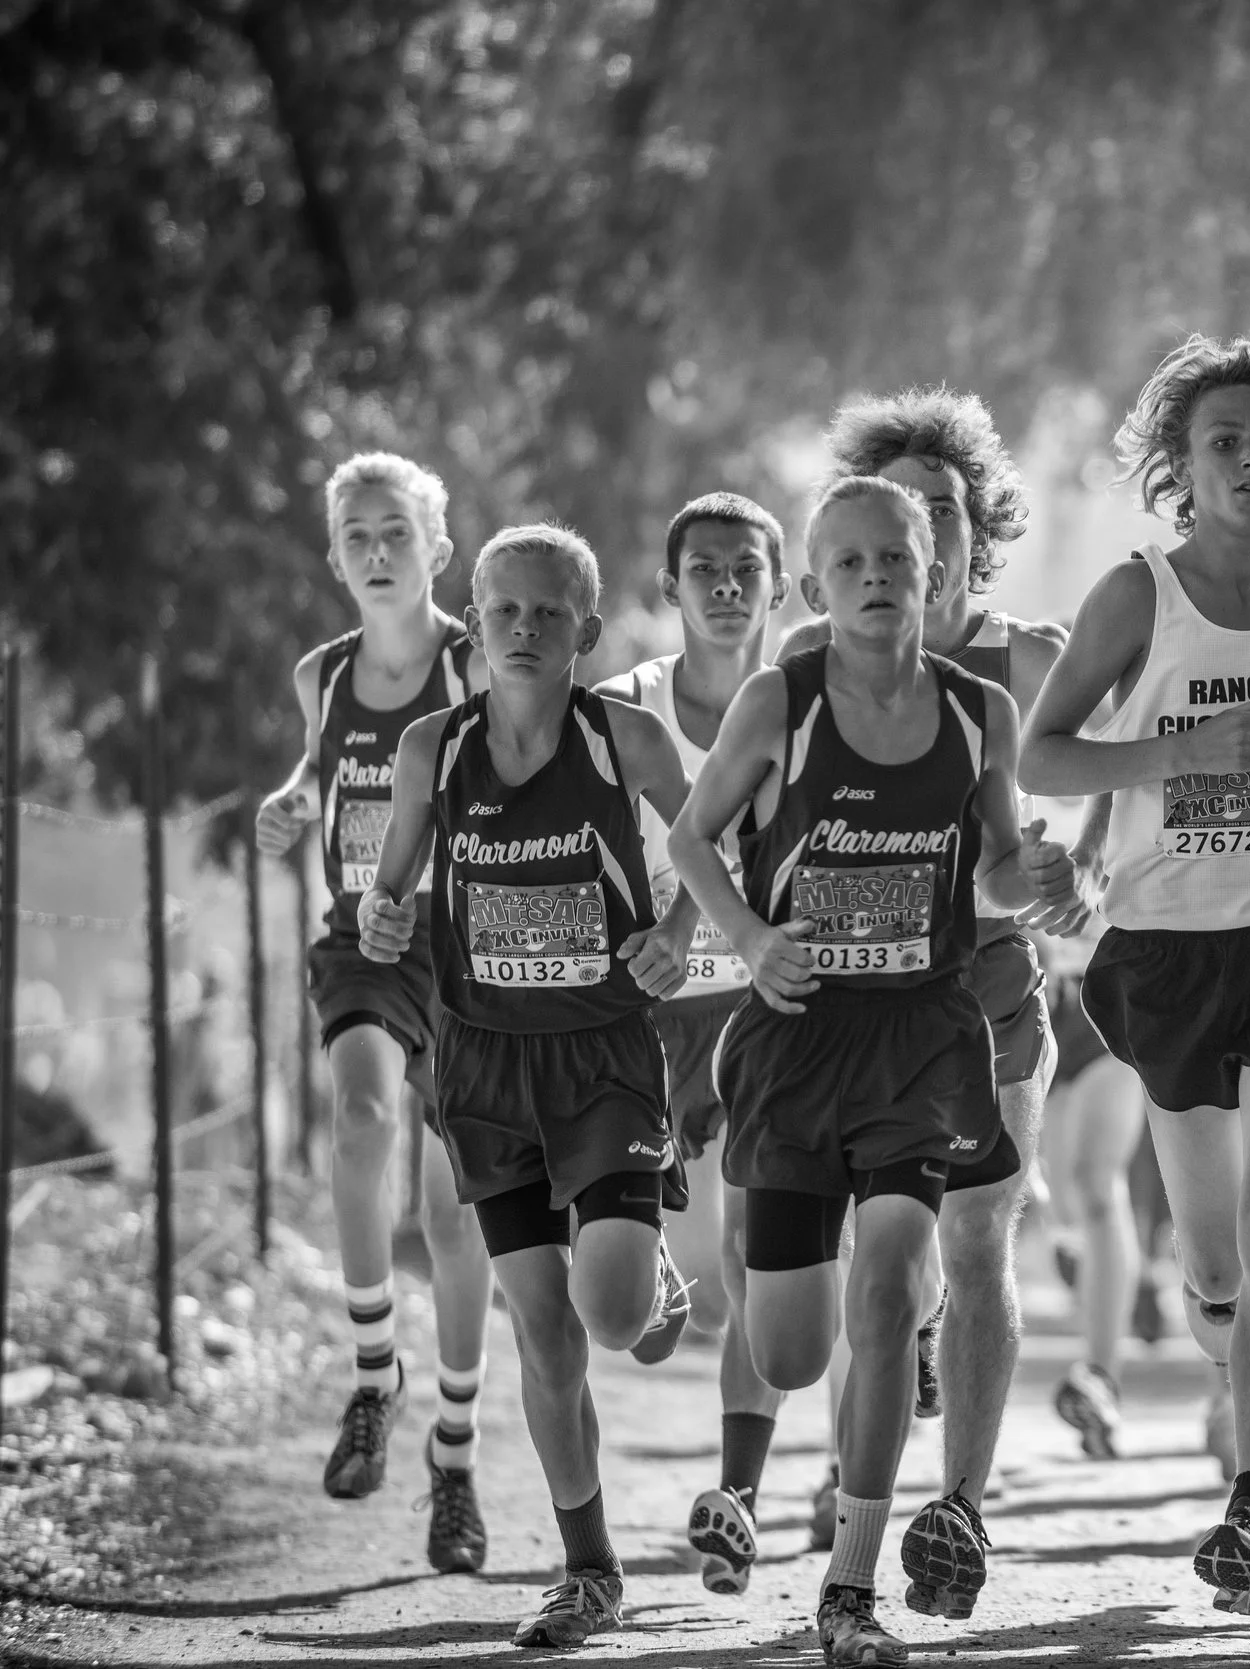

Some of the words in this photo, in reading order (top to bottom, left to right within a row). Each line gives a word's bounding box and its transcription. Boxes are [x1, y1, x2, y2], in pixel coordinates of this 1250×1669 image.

[338, 756, 393, 787] Clare
[1188, 795, 1226, 819] XC
[452, 821, 594, 865] Claremont
[809, 818, 958, 854] Claremont
[816, 912, 856, 935] XC
[857, 908, 916, 929] INVITE
[491, 928, 530, 949] XC
[530, 925, 589, 944] INVITE
